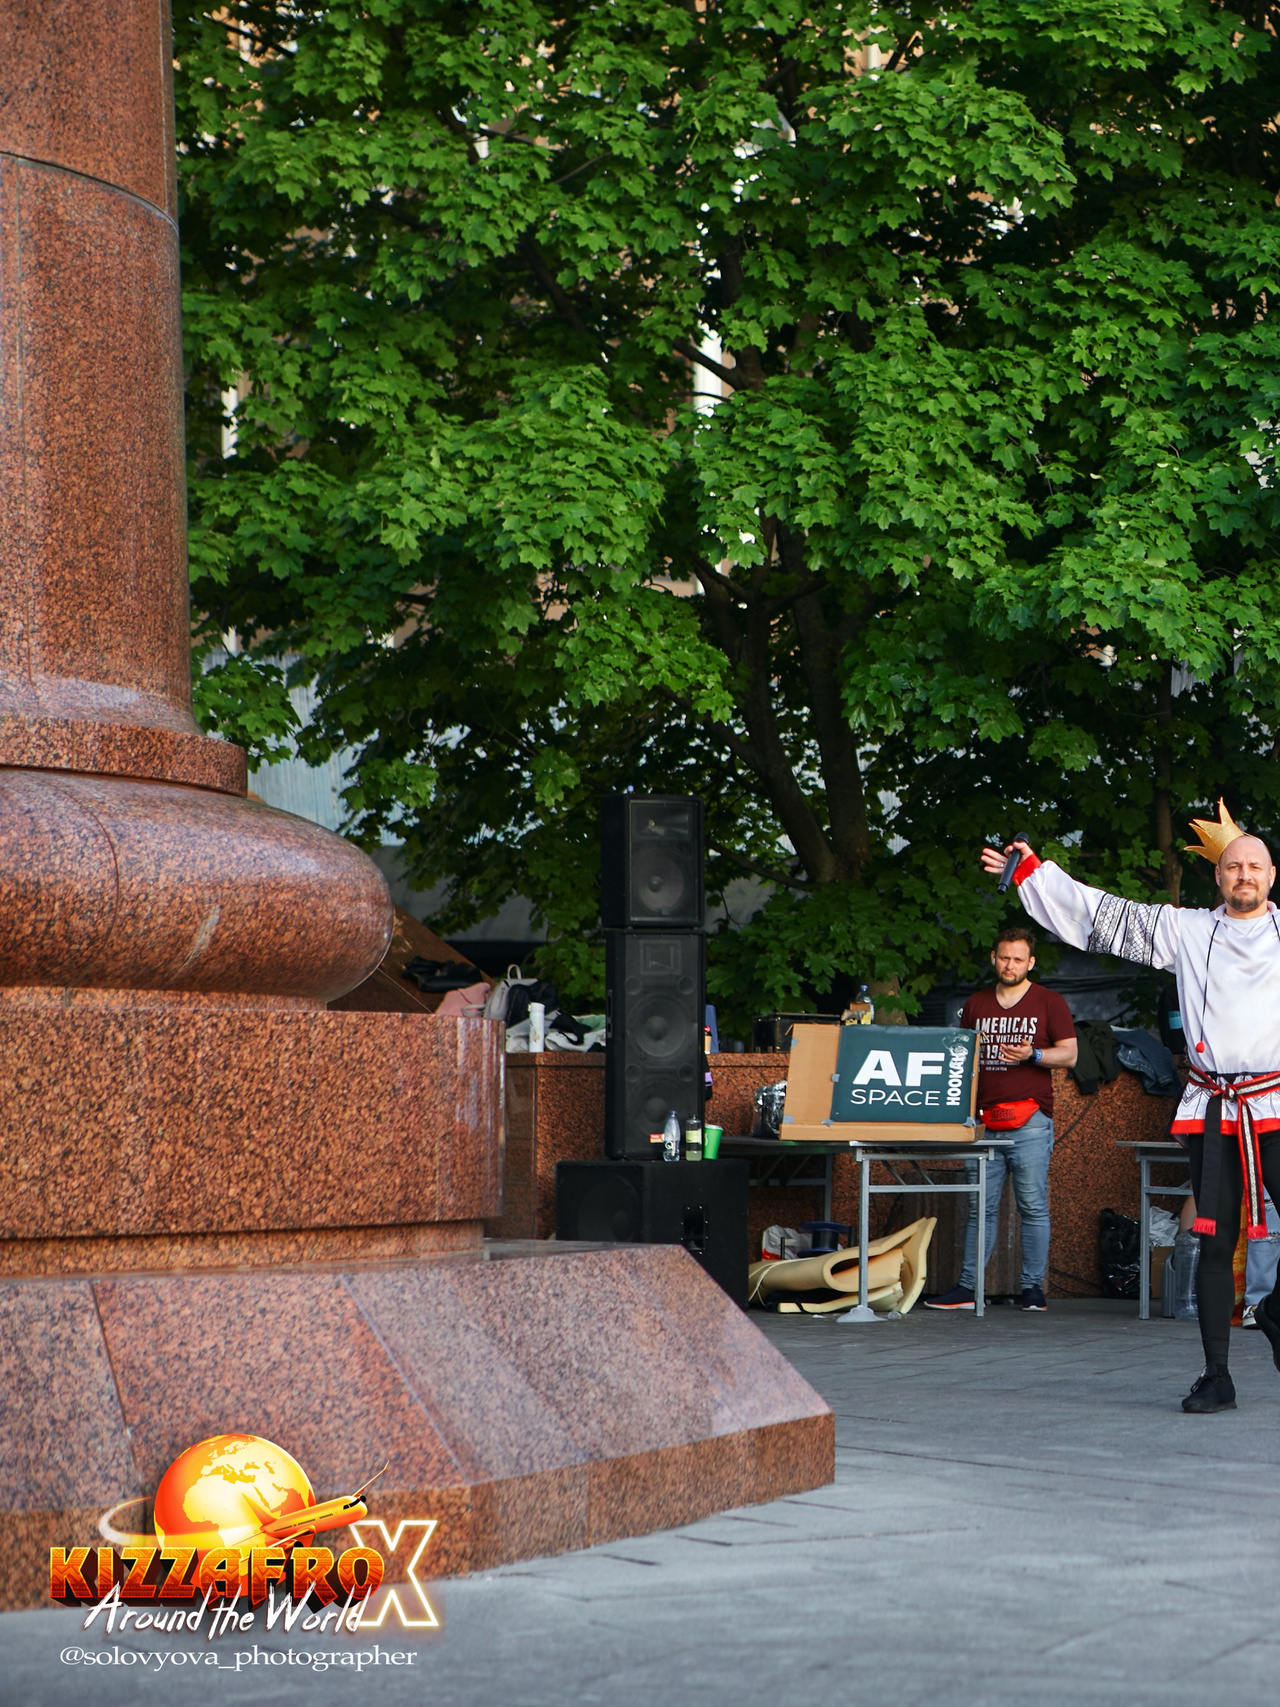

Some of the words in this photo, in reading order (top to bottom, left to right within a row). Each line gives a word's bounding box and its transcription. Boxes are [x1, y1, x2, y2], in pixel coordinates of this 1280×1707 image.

[975, 1017, 1038, 1034] AMERICAS
[995, 1035, 1023, 1044] VINTAGE
[852, 1049, 945, 1087] AF
[850, 1088, 941, 1106] SPACE
